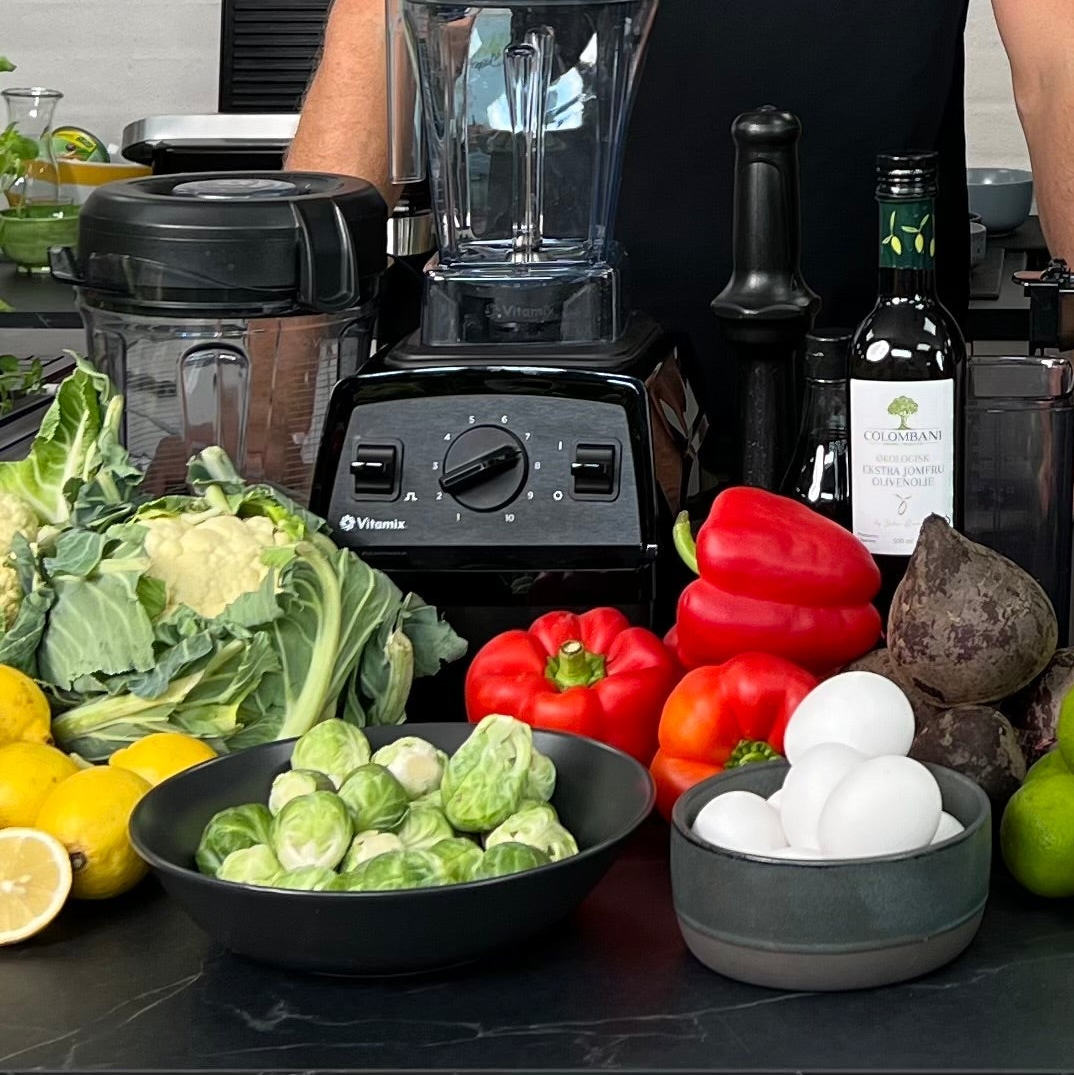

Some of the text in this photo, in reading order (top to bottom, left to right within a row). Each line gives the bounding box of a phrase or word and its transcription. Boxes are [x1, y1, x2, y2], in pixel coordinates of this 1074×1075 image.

[469, 415, 475, 424] 5
[501, 415, 508, 424] 6
[443, 432, 450, 441] 4
[525, 432, 531, 441] 7
[863, 430, 942, 442] COLOMBANI
[432, 461, 439, 470] 3
[534, 461, 541, 470] 8
[862, 465, 901, 476] EKSTRA
[871, 477, 935, 488] OLIVENOLIE
[435, 491, 443, 500] 2
[527, 491, 534, 500] 9
[456, 512, 461, 522] 1
[505, 513, 515, 522] 10
[356, 516, 406, 530] Vitamix
